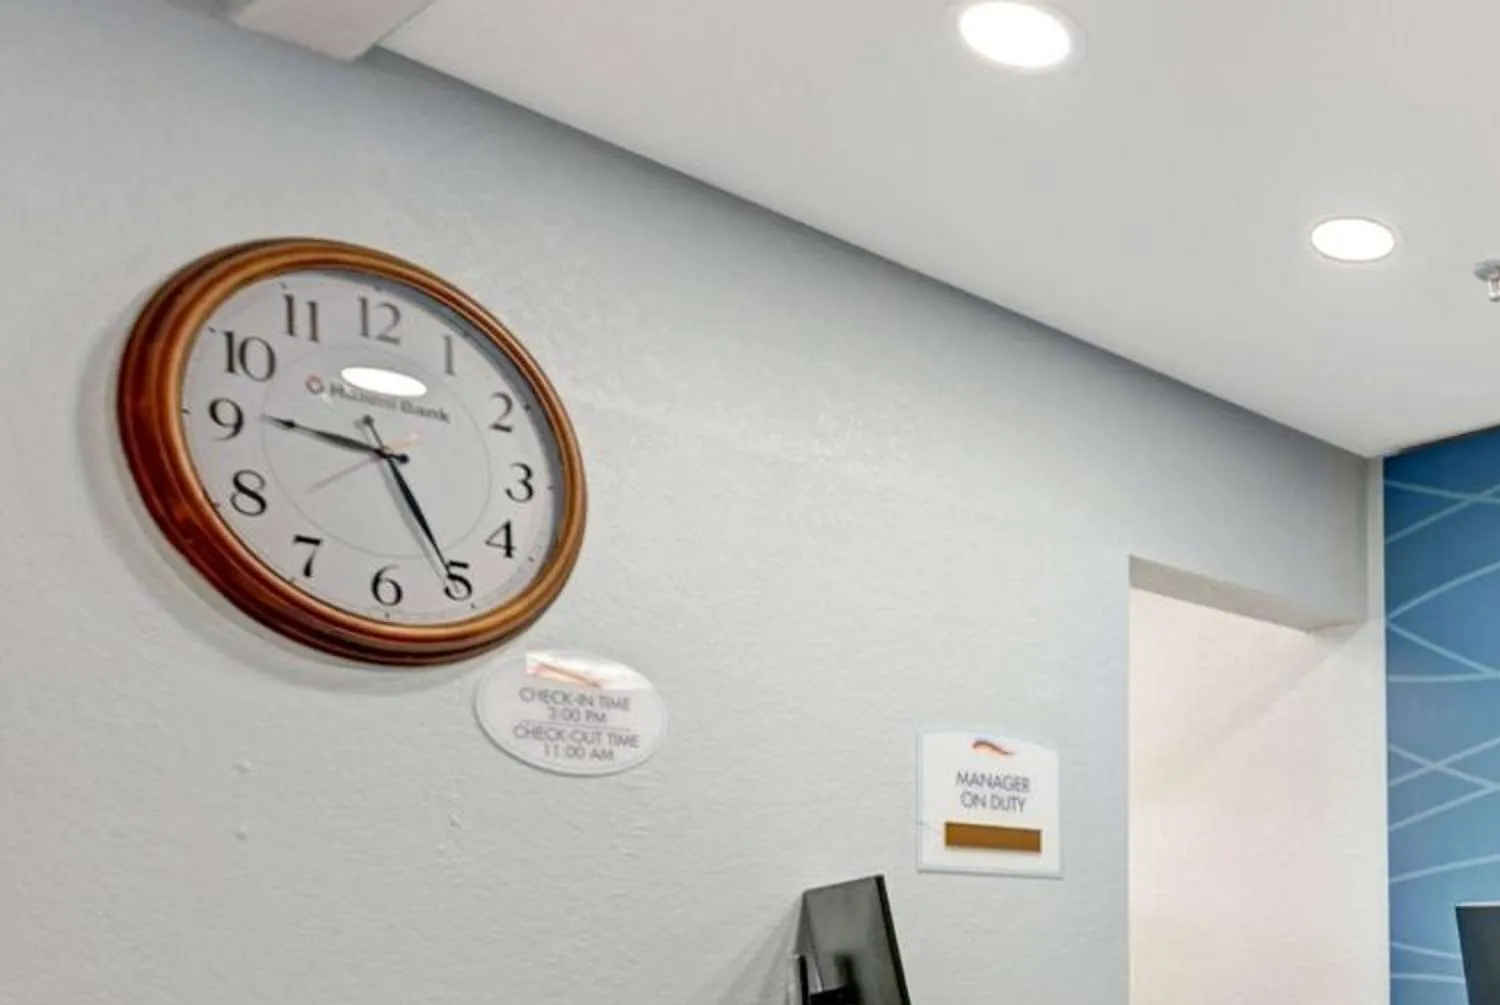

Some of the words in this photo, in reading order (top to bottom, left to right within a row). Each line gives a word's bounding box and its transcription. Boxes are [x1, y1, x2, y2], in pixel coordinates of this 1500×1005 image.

[283, 292, 321, 343] 11
[358, 296, 401, 345] 12
[222, 331, 276, 382] 10
[443, 335, 456, 376] 1
[208, 398, 244, 441] 9
[489, 392, 513, 433] 2
[231, 470, 267, 516] 8
[506, 463, 534, 502] 3
[293, 535, 324, 578] 7
[485, 521, 517, 558] 4
[371, 565, 403, 606] 6
[443, 561, 474, 601] 5
[586, 710, 607, 723] PM
[598, 695, 631, 711] TIME
[591, 748, 614, 760] AM
[608, 733, 640, 748] TIME
[956, 770, 1030, 793] MANAGER
[960, 791, 986, 809] ON
[990, 794, 1027, 812] DUTY
